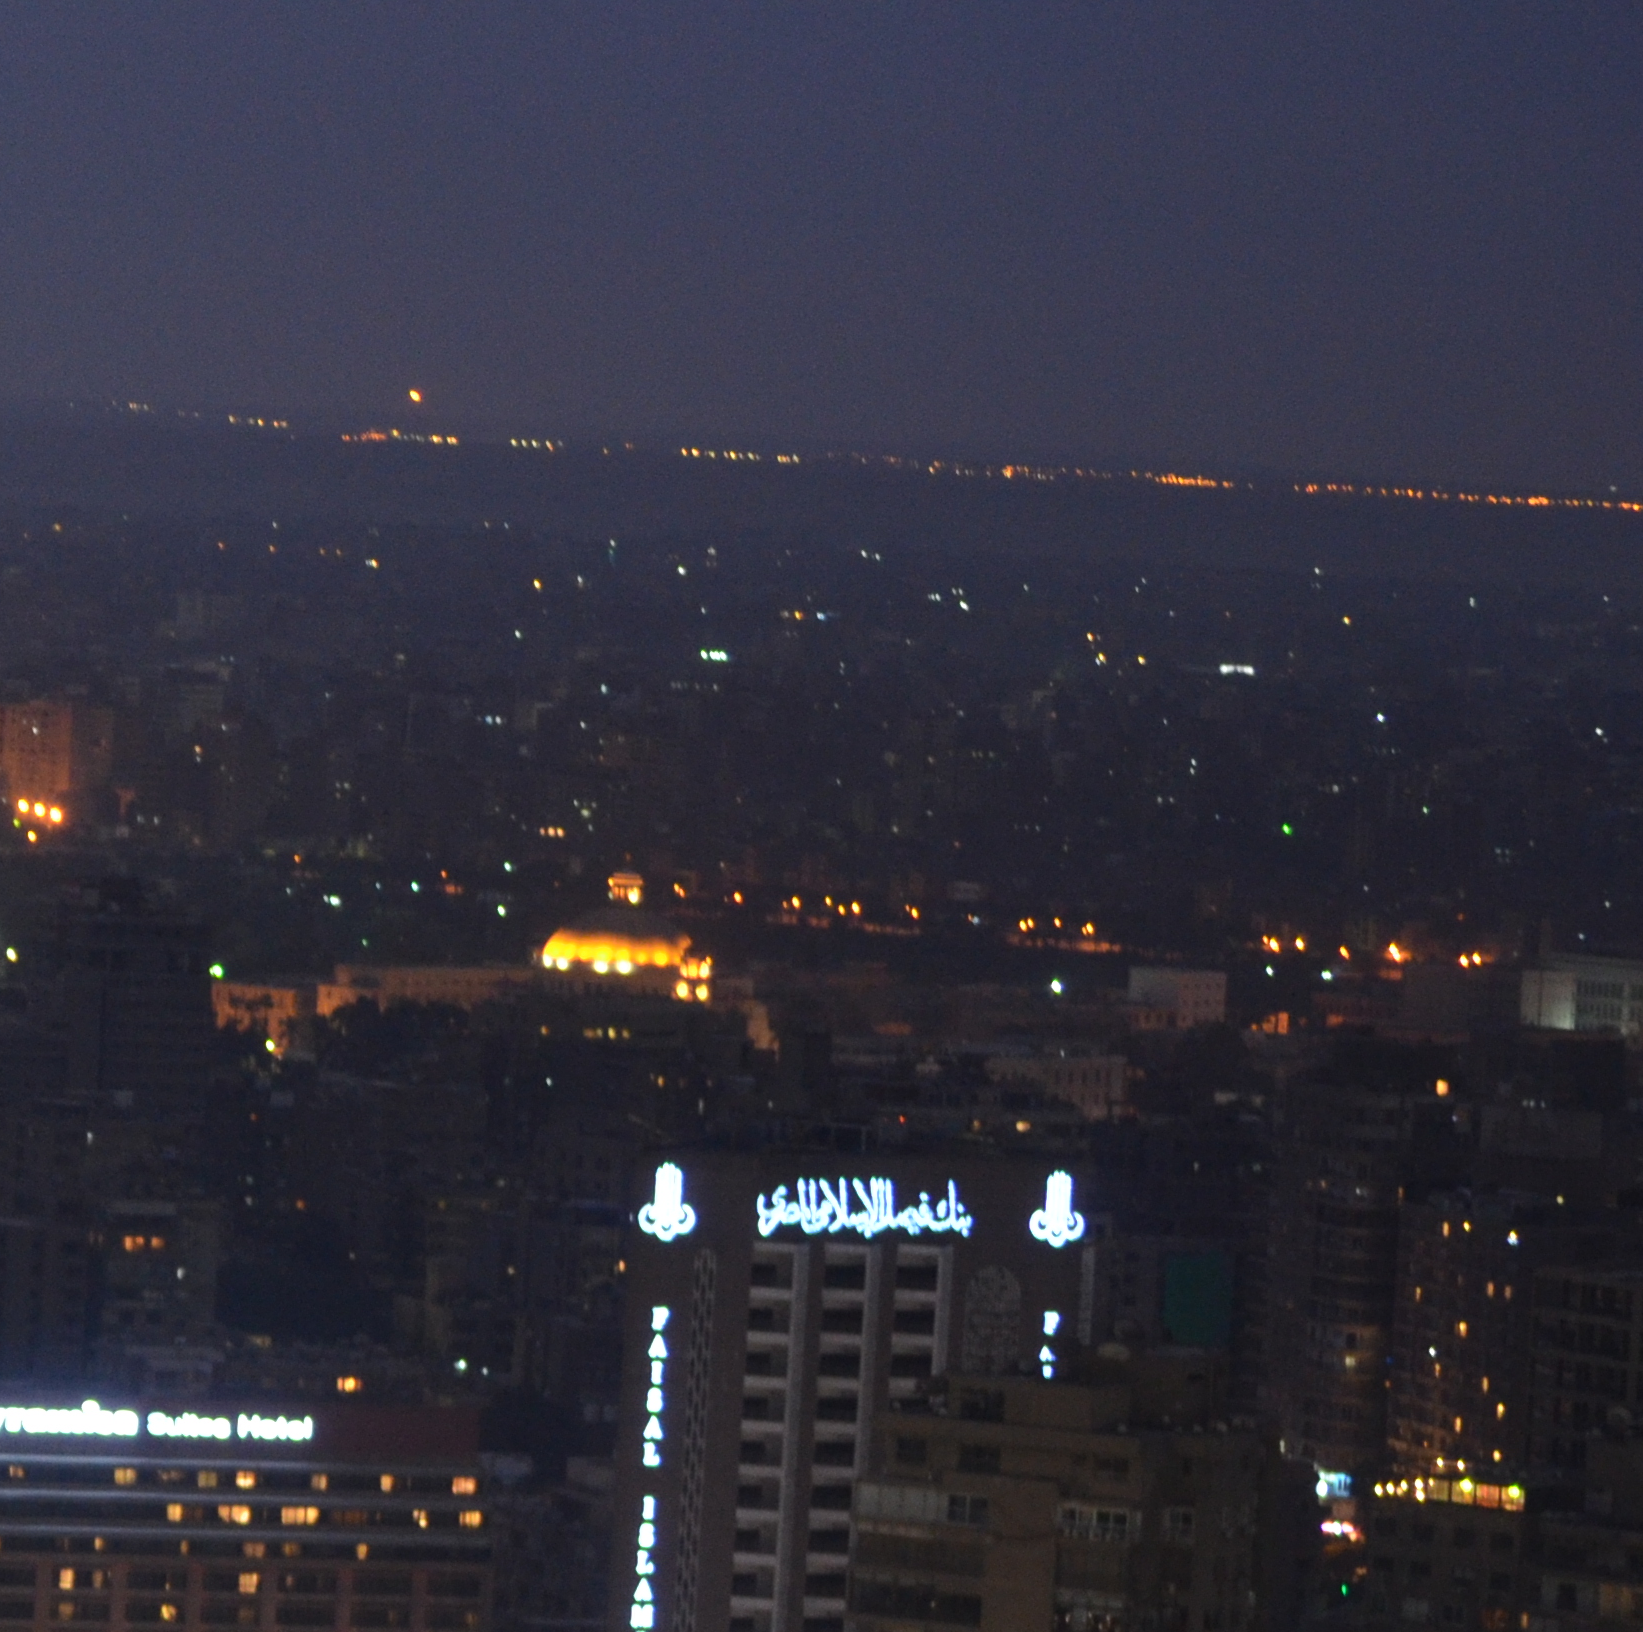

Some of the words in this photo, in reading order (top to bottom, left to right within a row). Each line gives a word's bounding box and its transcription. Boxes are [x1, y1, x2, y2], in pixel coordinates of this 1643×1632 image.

[147, 1412, 231, 1439] Suites
[238, 1414, 312, 1441] Hotel
[643, 1306, 672, 1467] FAISAL
